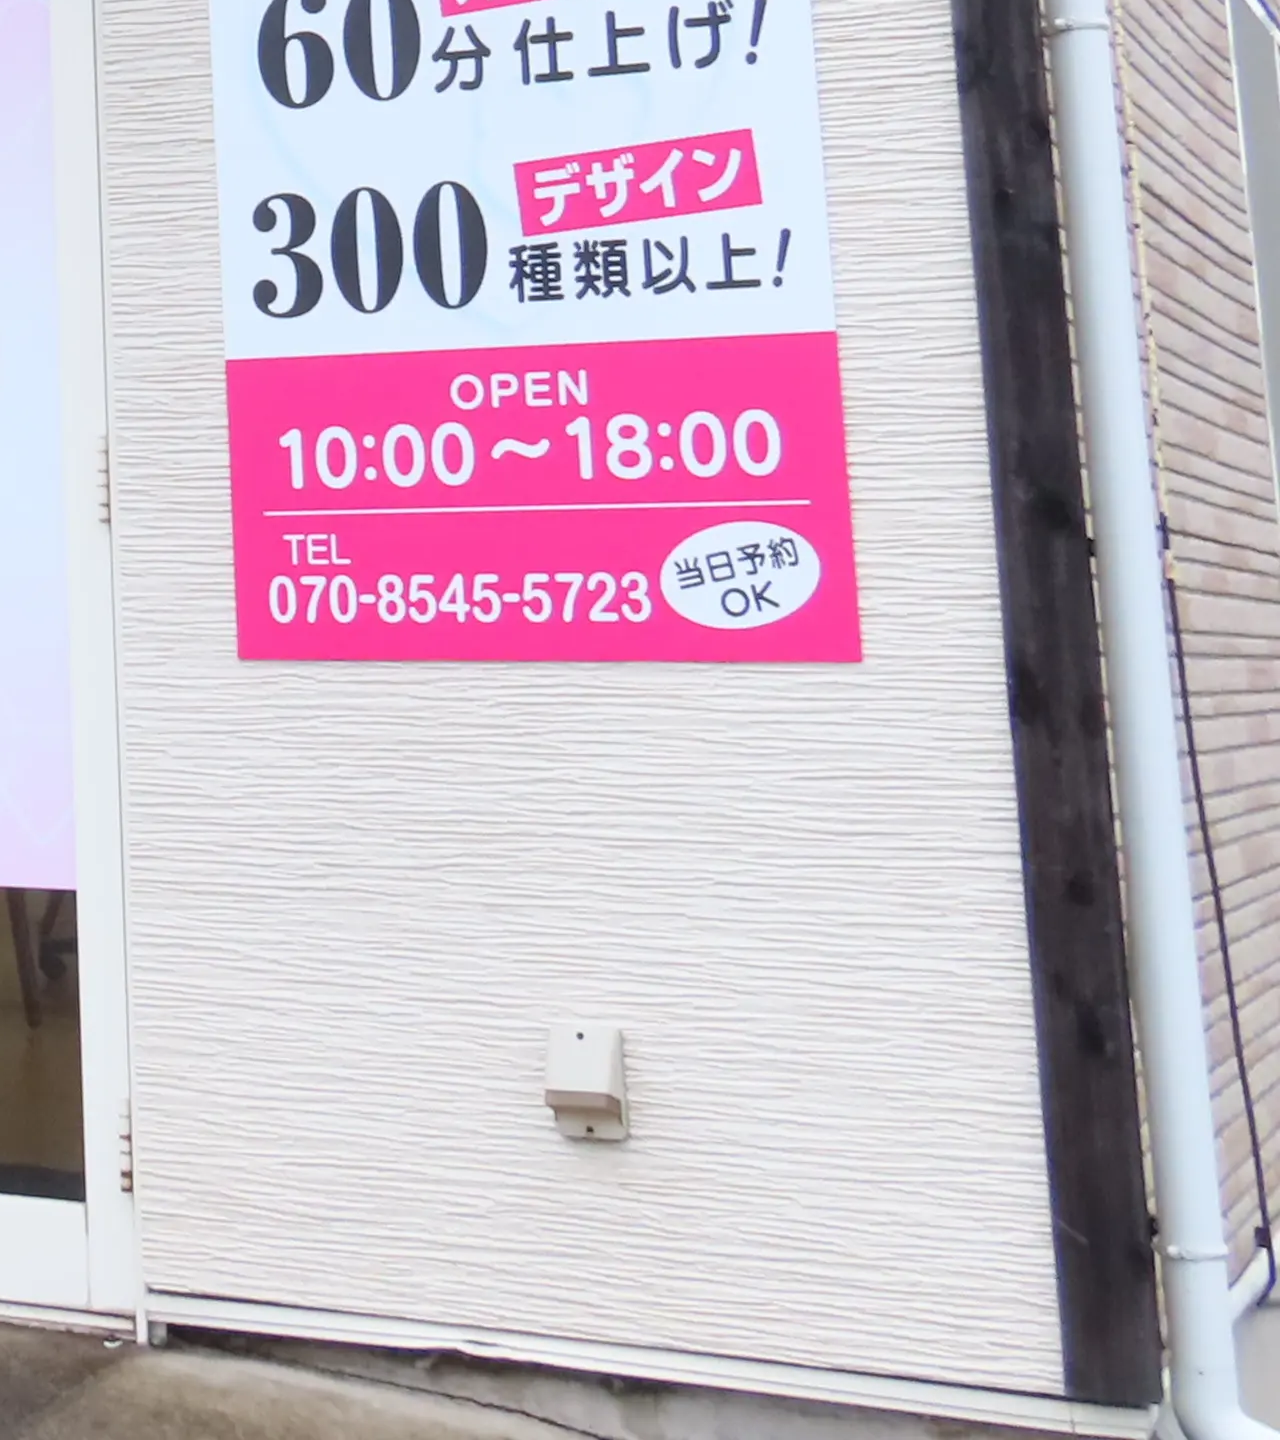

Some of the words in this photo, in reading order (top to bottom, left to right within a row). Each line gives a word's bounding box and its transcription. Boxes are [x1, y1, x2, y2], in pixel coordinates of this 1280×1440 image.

[533, 143, 742, 227] デザイン
[450, 369, 588, 411] OPEN
[283, 533, 351, 566] TEL
[675, 536, 800, 590] 当日予約
[269, 571, 652, 625] 070-8545-5723
[721, 582, 780, 618] OK
